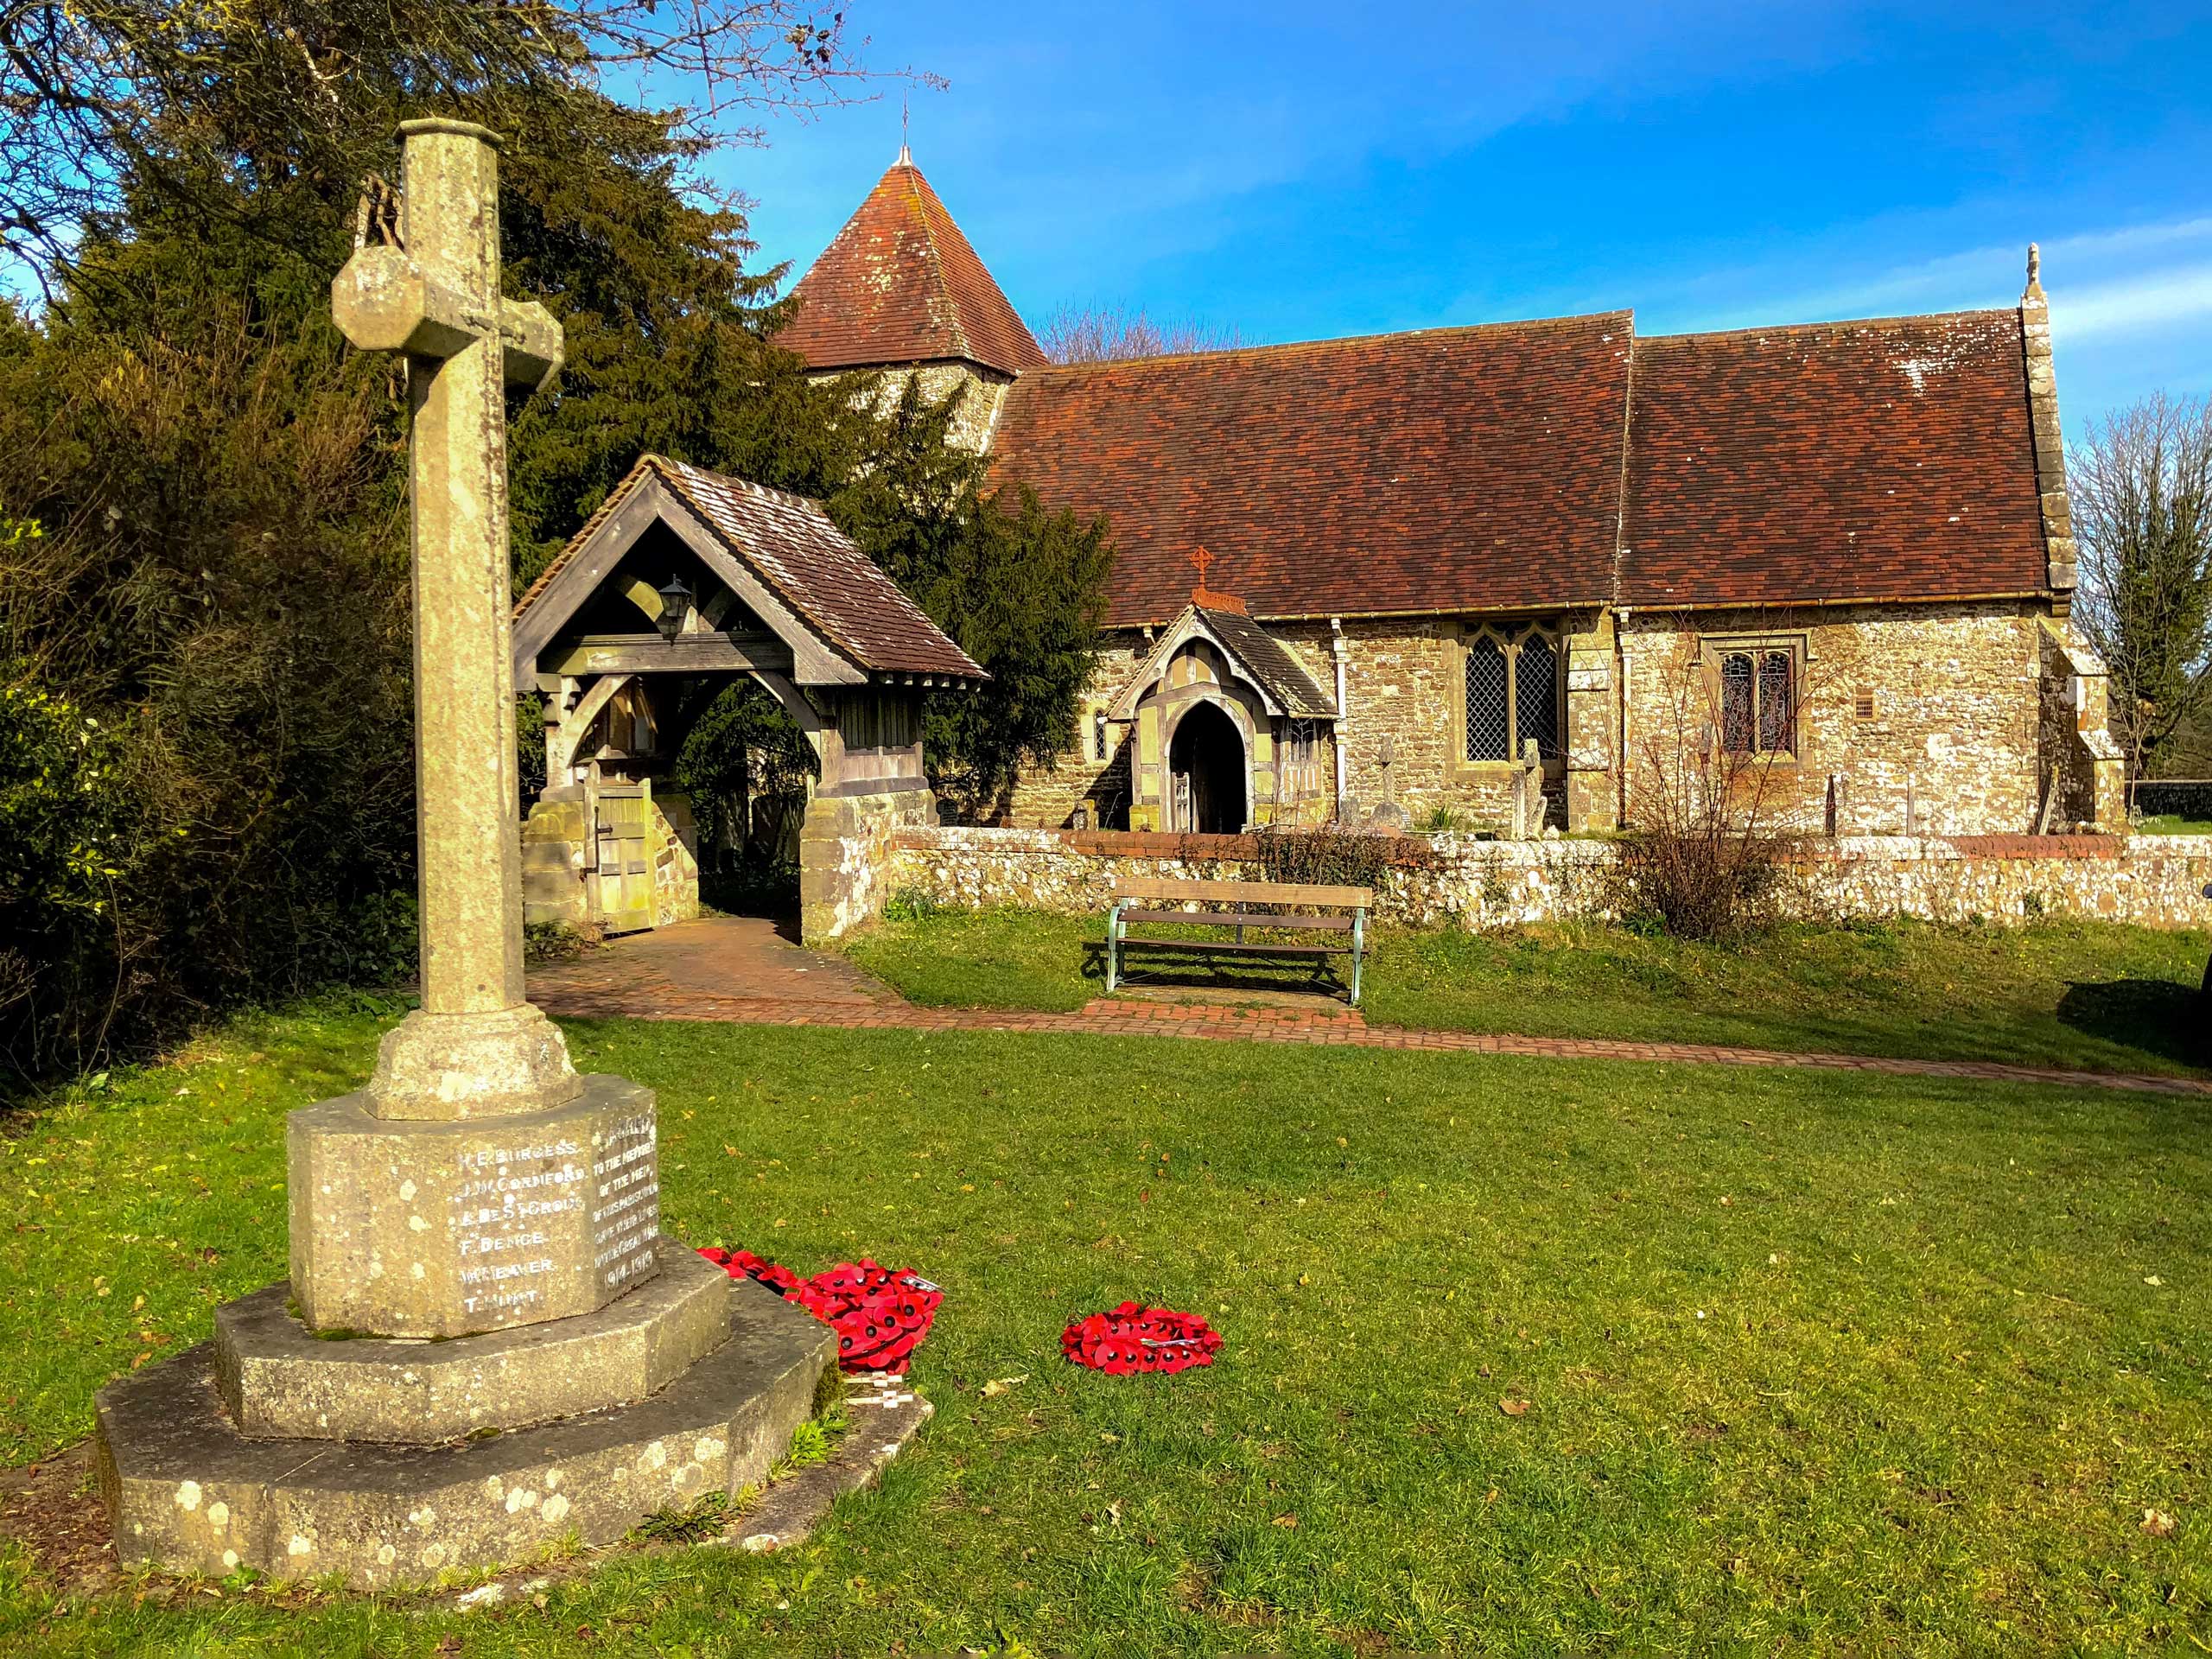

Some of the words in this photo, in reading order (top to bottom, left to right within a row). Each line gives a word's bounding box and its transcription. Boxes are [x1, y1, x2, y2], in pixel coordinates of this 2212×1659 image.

[594, 1162, 604, 1176] TO
[605, 1154, 621, 1172] THE
[600, 1182, 611, 1198] OF
[613, 1173, 629, 1191] THE
[593, 1210, 602, 1223] OF
[603, 1201, 620, 1217] THIS
[594, 1228, 614, 1244] GAVE
[616, 1215, 637, 1234] THEIR
[601, 1249, 620, 1264] THE
[619, 1236, 640, 1255] GREAT
[642, 1224, 658, 1241] WAR
